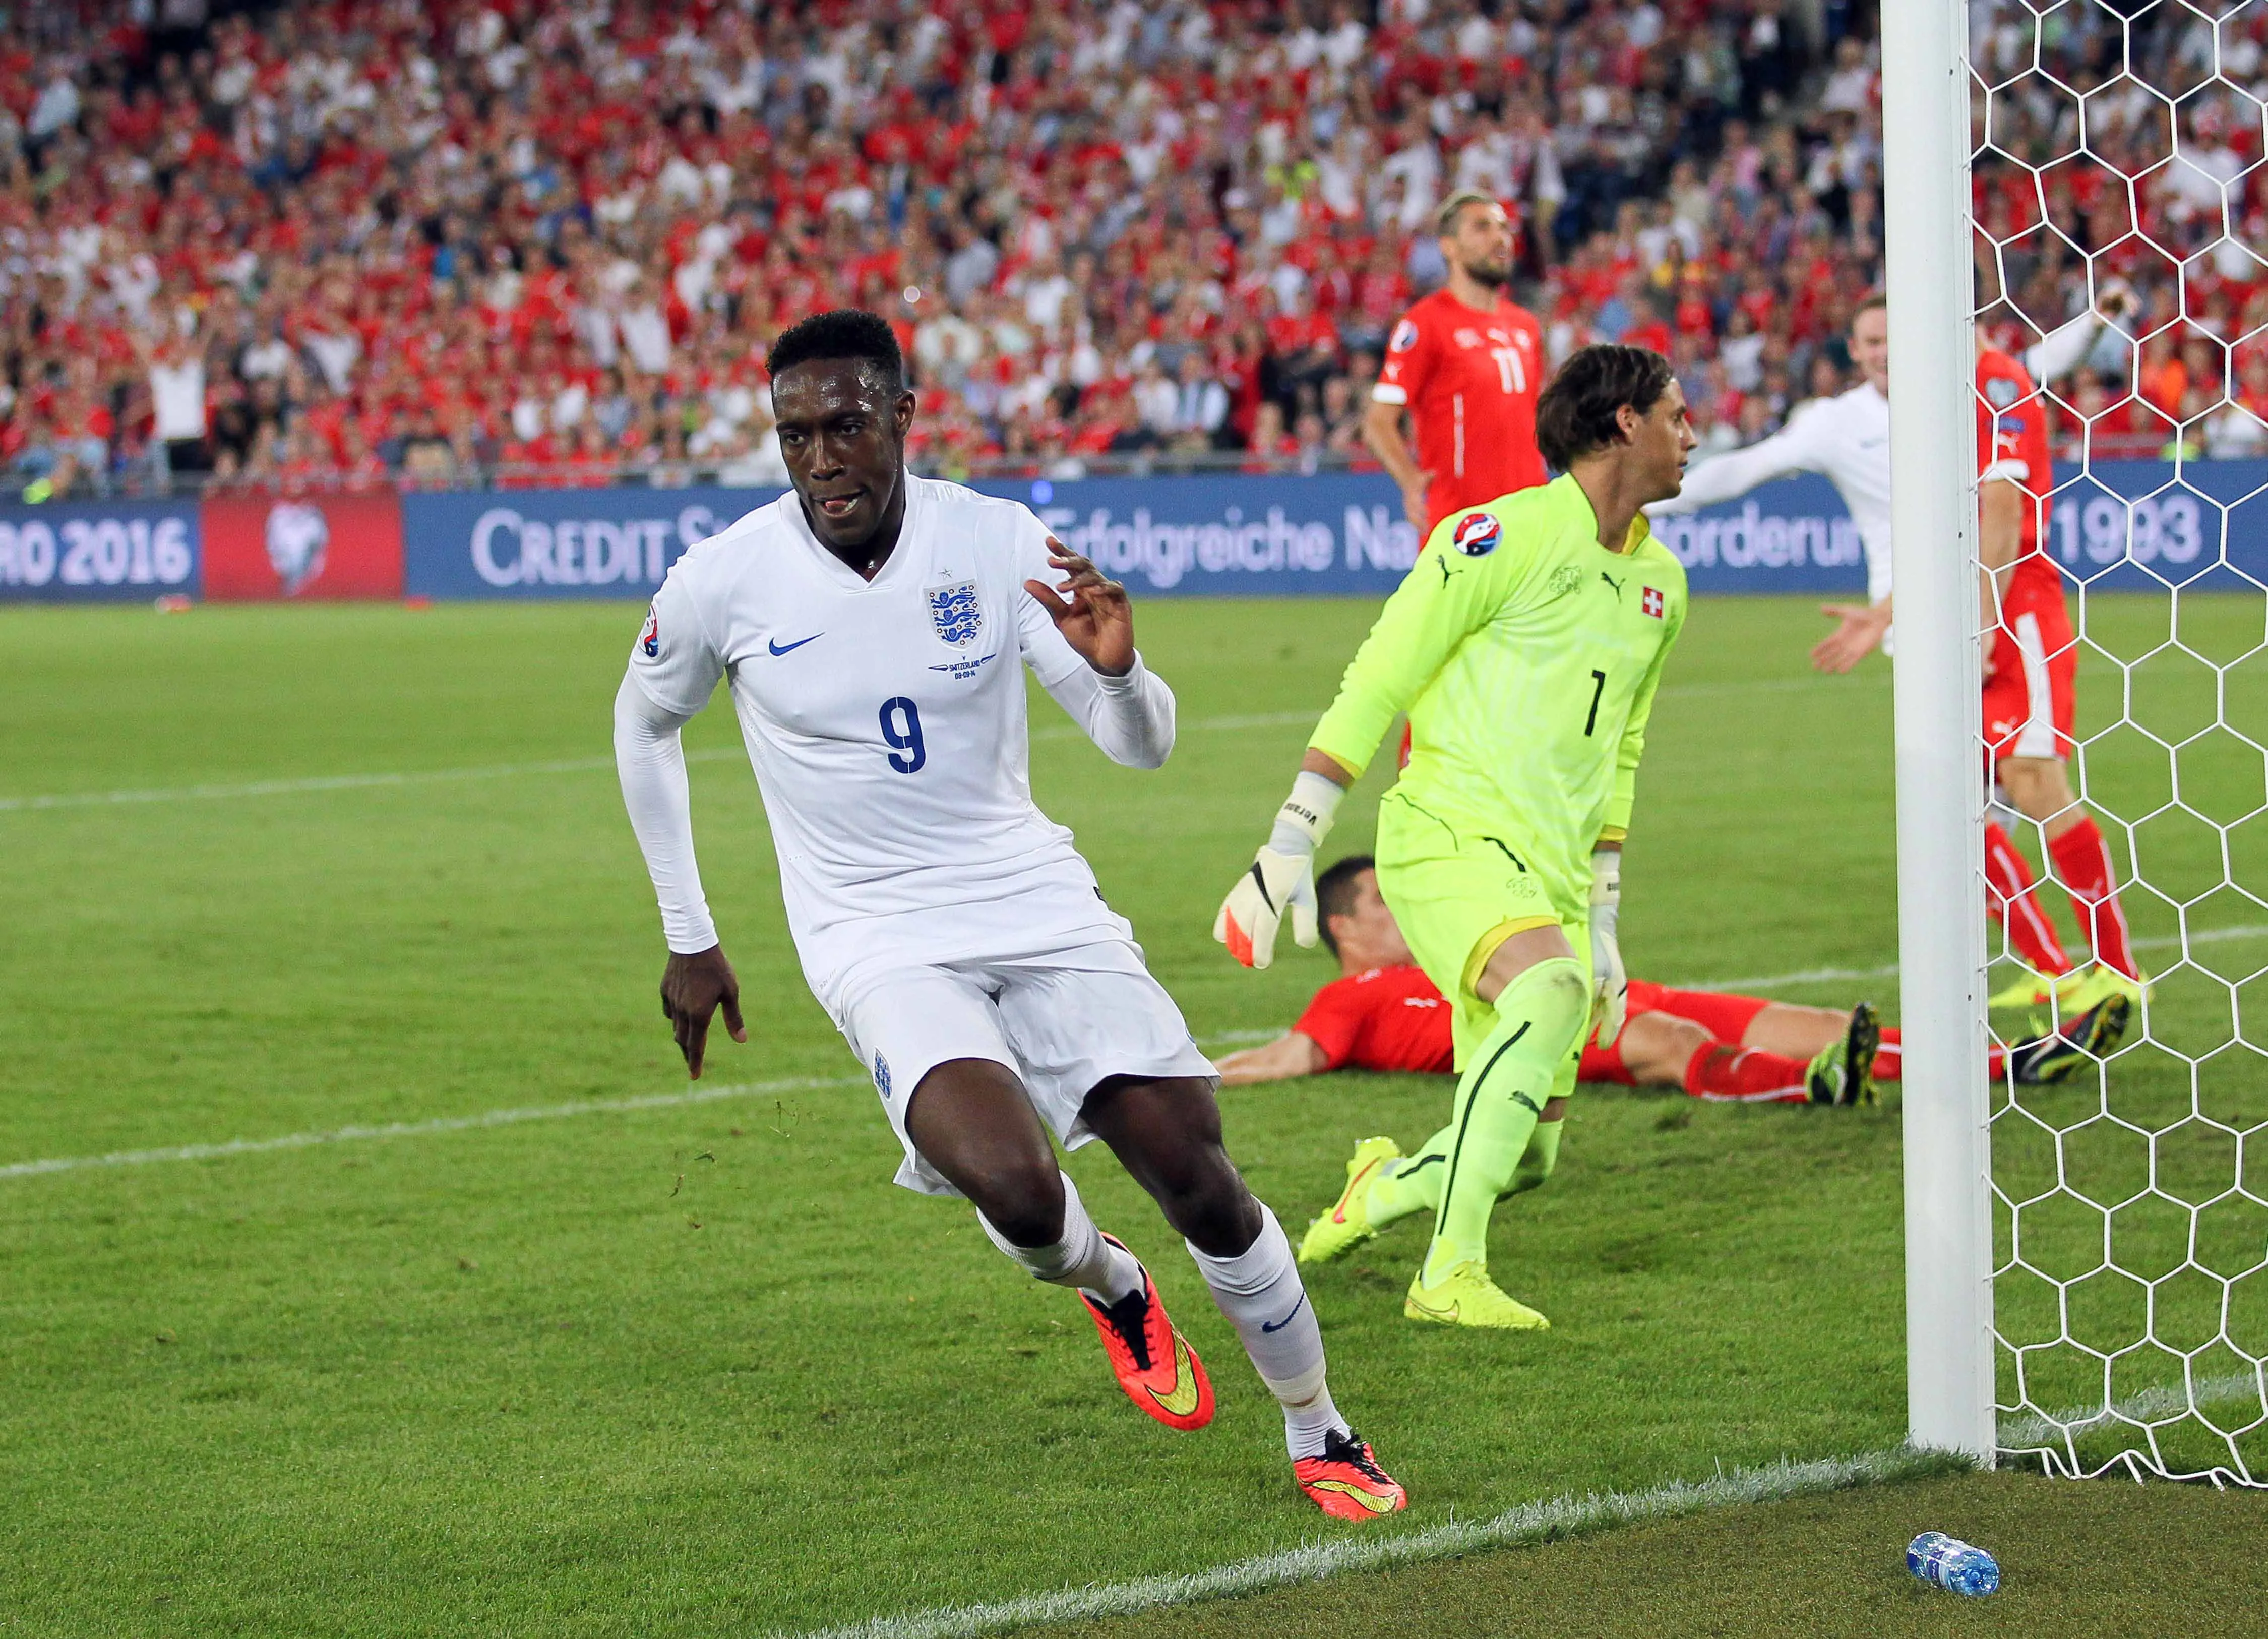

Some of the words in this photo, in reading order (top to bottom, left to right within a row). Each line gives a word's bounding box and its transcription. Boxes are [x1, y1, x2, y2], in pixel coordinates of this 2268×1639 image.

[1490, 347, 1526, 394] 11
[59, 518, 191, 586] 2016
[471, 507, 672, 587] CREDIT
[677, 505, 730, 548] S
[2051, 494, 2203, 565] 1993
[949, 660, 980, 672] SWITZERLAND
[879, 696, 926, 774] 9
[1585, 670, 1605, 736] 1
